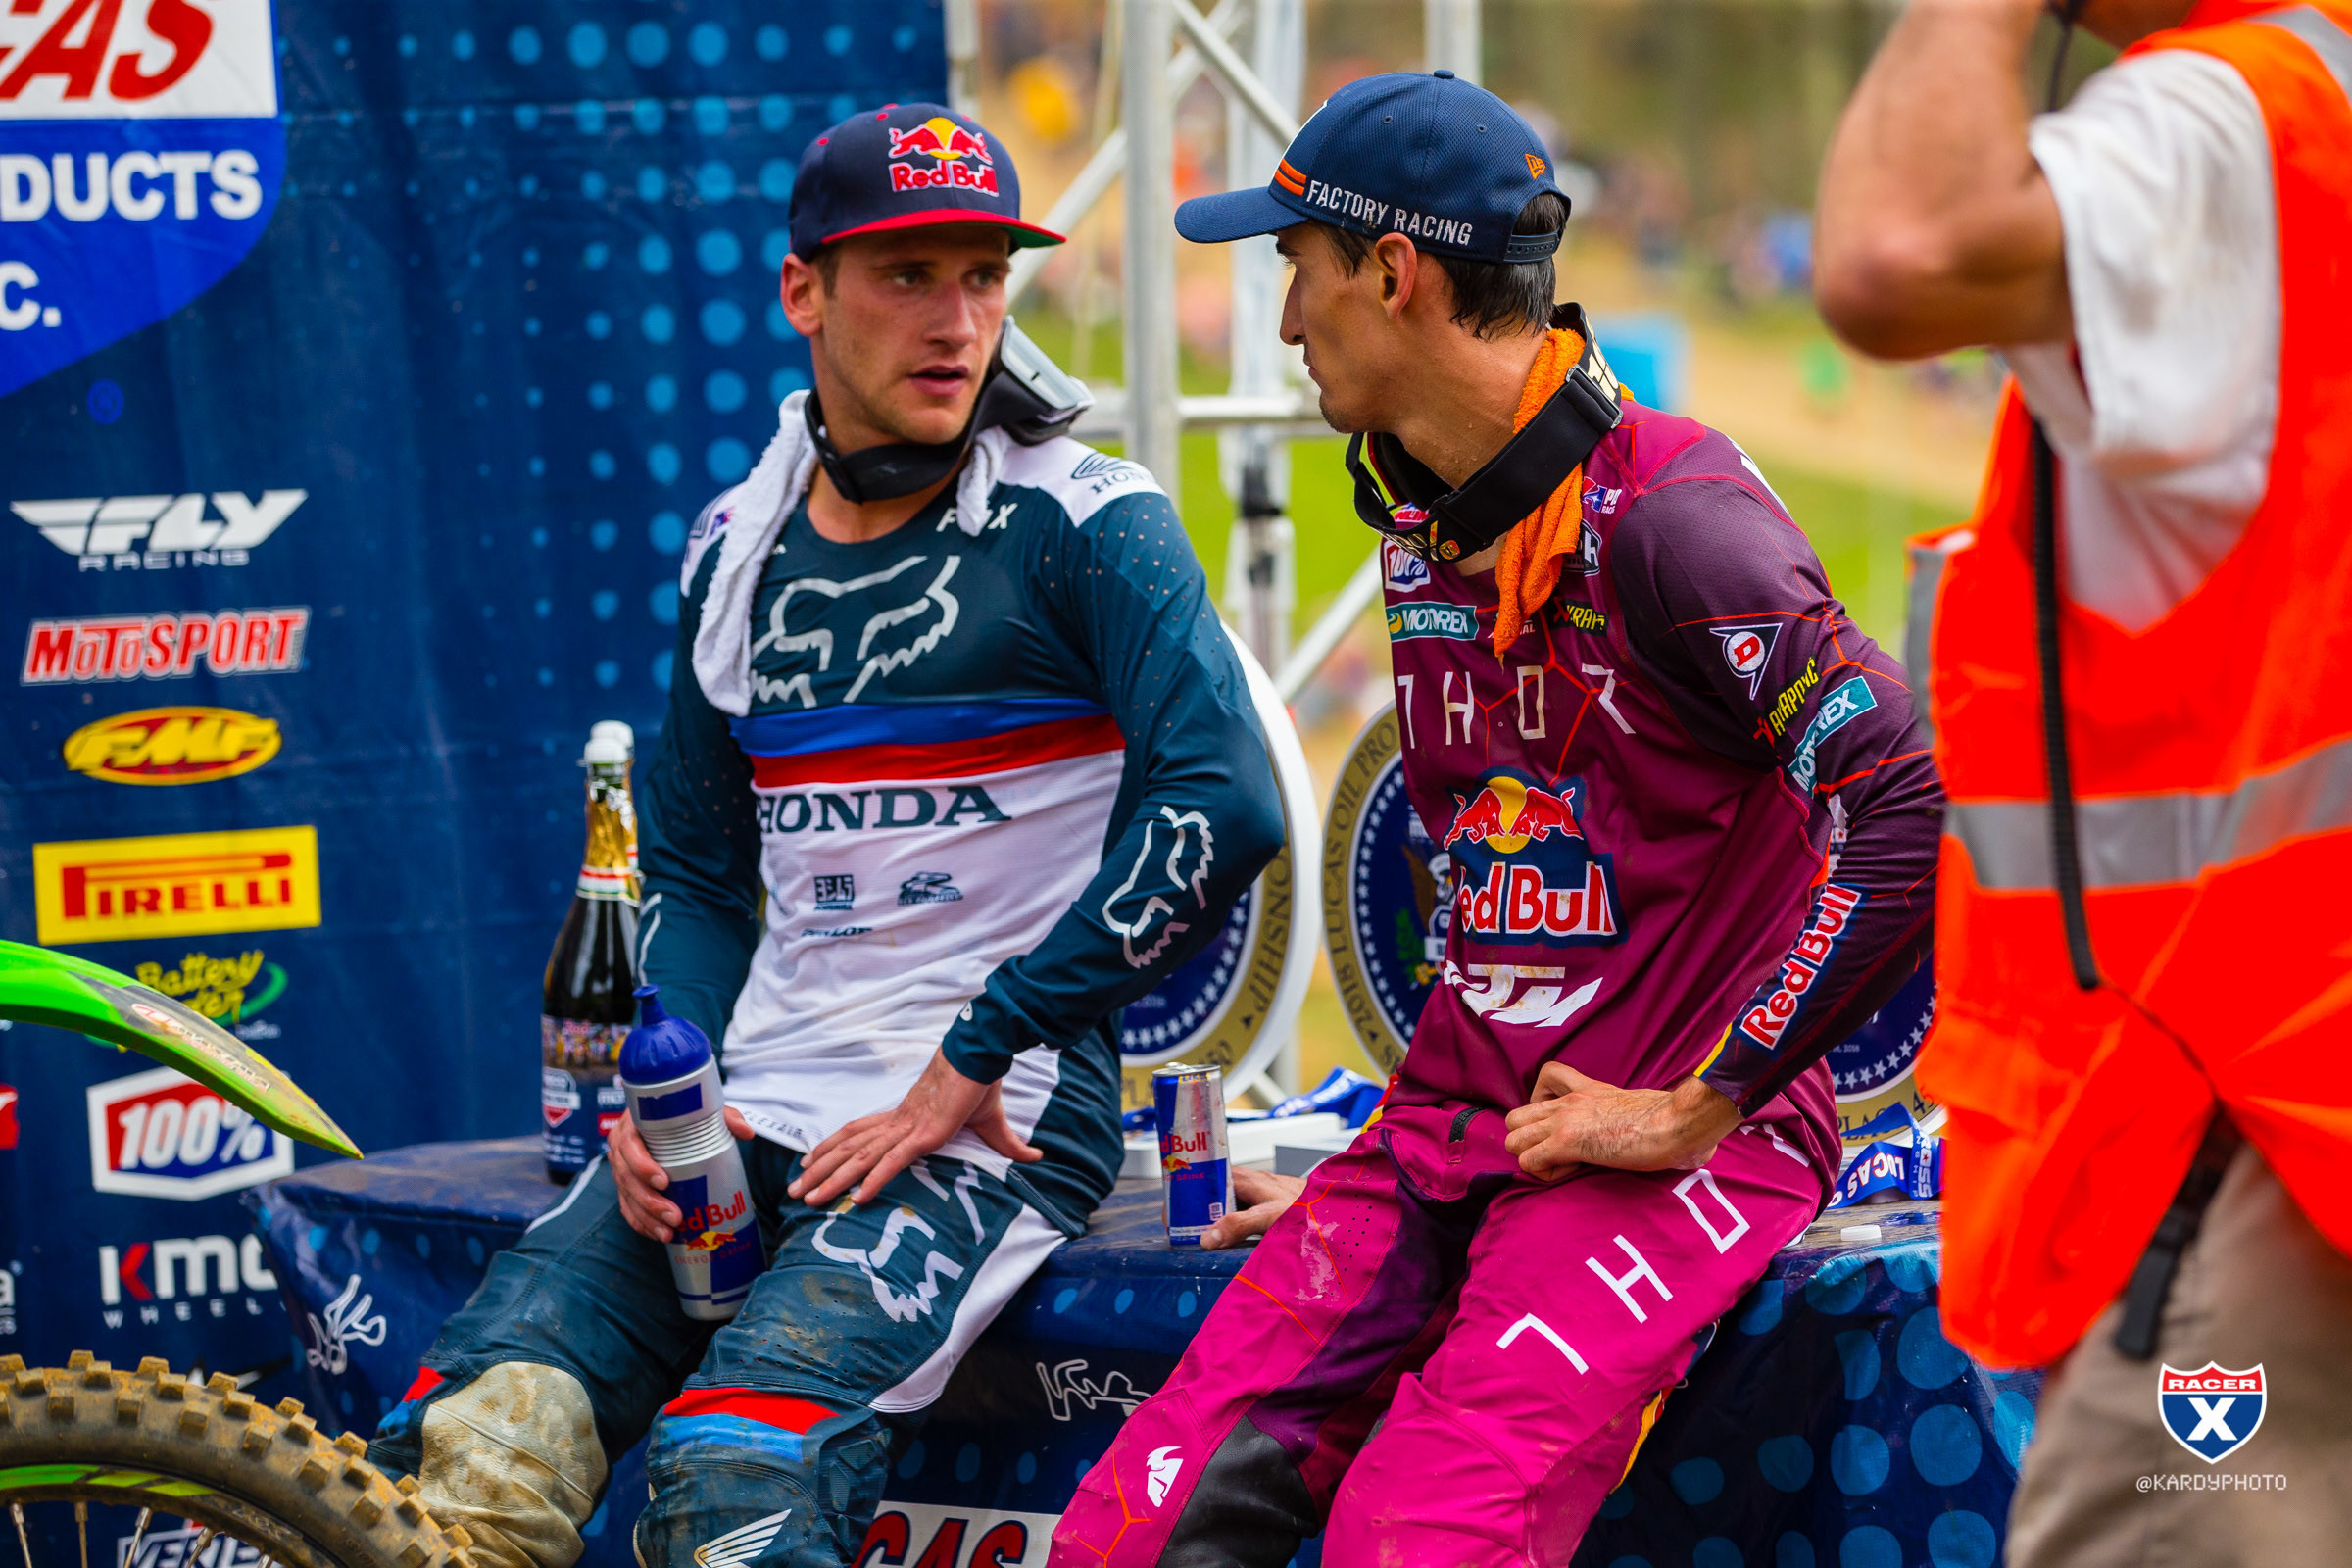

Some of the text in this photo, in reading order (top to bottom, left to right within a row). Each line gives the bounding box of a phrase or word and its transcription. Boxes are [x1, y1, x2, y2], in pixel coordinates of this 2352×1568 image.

[0, 149, 263, 222] DUCTS
[889, 160, 999, 197] Red Bull
[1306, 179, 1474, 247] FACTORY RACING
[0, 261, 62, 331] C.
[10, 489, 309, 555] FLY
[936, 503, 1018, 532] FX
[78, 548, 250, 571] RACING
[65, 717, 279, 770] FMF
[1354, 721, 1398, 779] PRO
[756, 785, 1012, 834] HONDA
[61, 853, 292, 920] PIRELLI
[1458, 860, 1618, 937] ed Bull
[1739, 883, 1863, 1051] Red Bull
[117, 1095, 268, 1169] 100%
[1171, 1132, 1207, 1153] Bull
[1848, 1152, 1905, 1199] LUCAS
[705, 1190, 747, 1226] Bull
[103, 1298, 286, 1329] WHEEL
